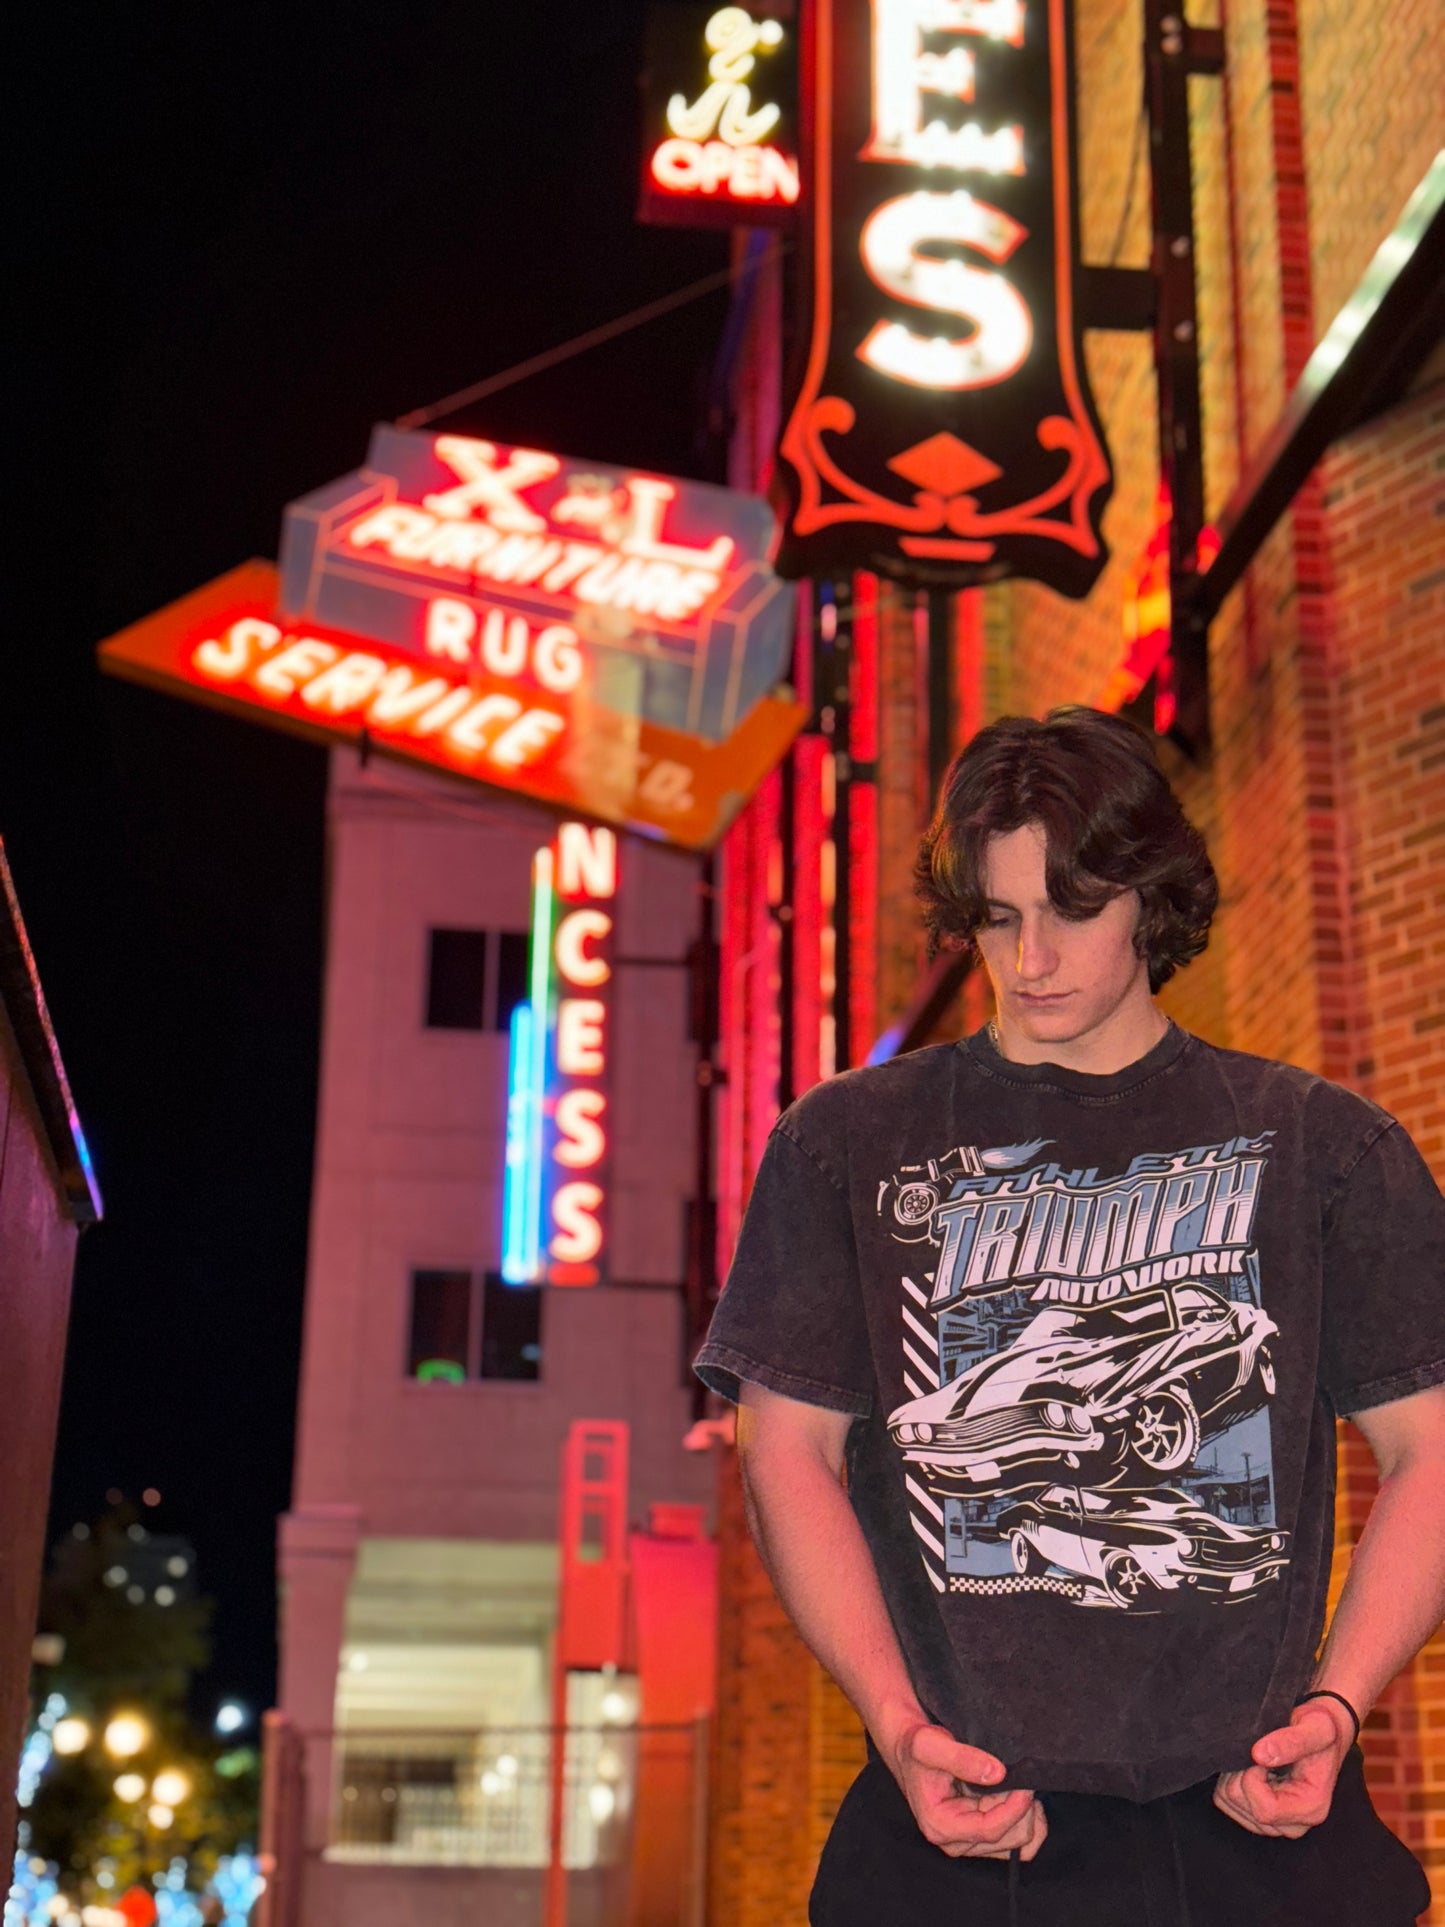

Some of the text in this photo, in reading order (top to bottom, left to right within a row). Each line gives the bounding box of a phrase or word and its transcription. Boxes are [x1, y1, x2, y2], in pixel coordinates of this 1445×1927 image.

[651, 137, 800, 205] OPEN
[349, 502, 722, 620] FURNITURE
[196, 616, 566, 769] SERVICE
[427, 597, 584, 694] RUG
[548, 821, 618, 1264] NCESS
[948, 1131, 1277, 1200] ATHLETIC
[930, 1158, 1266, 1306] TRIUMPH
[1029, 1249, 1246, 1305] AUTOWORK
